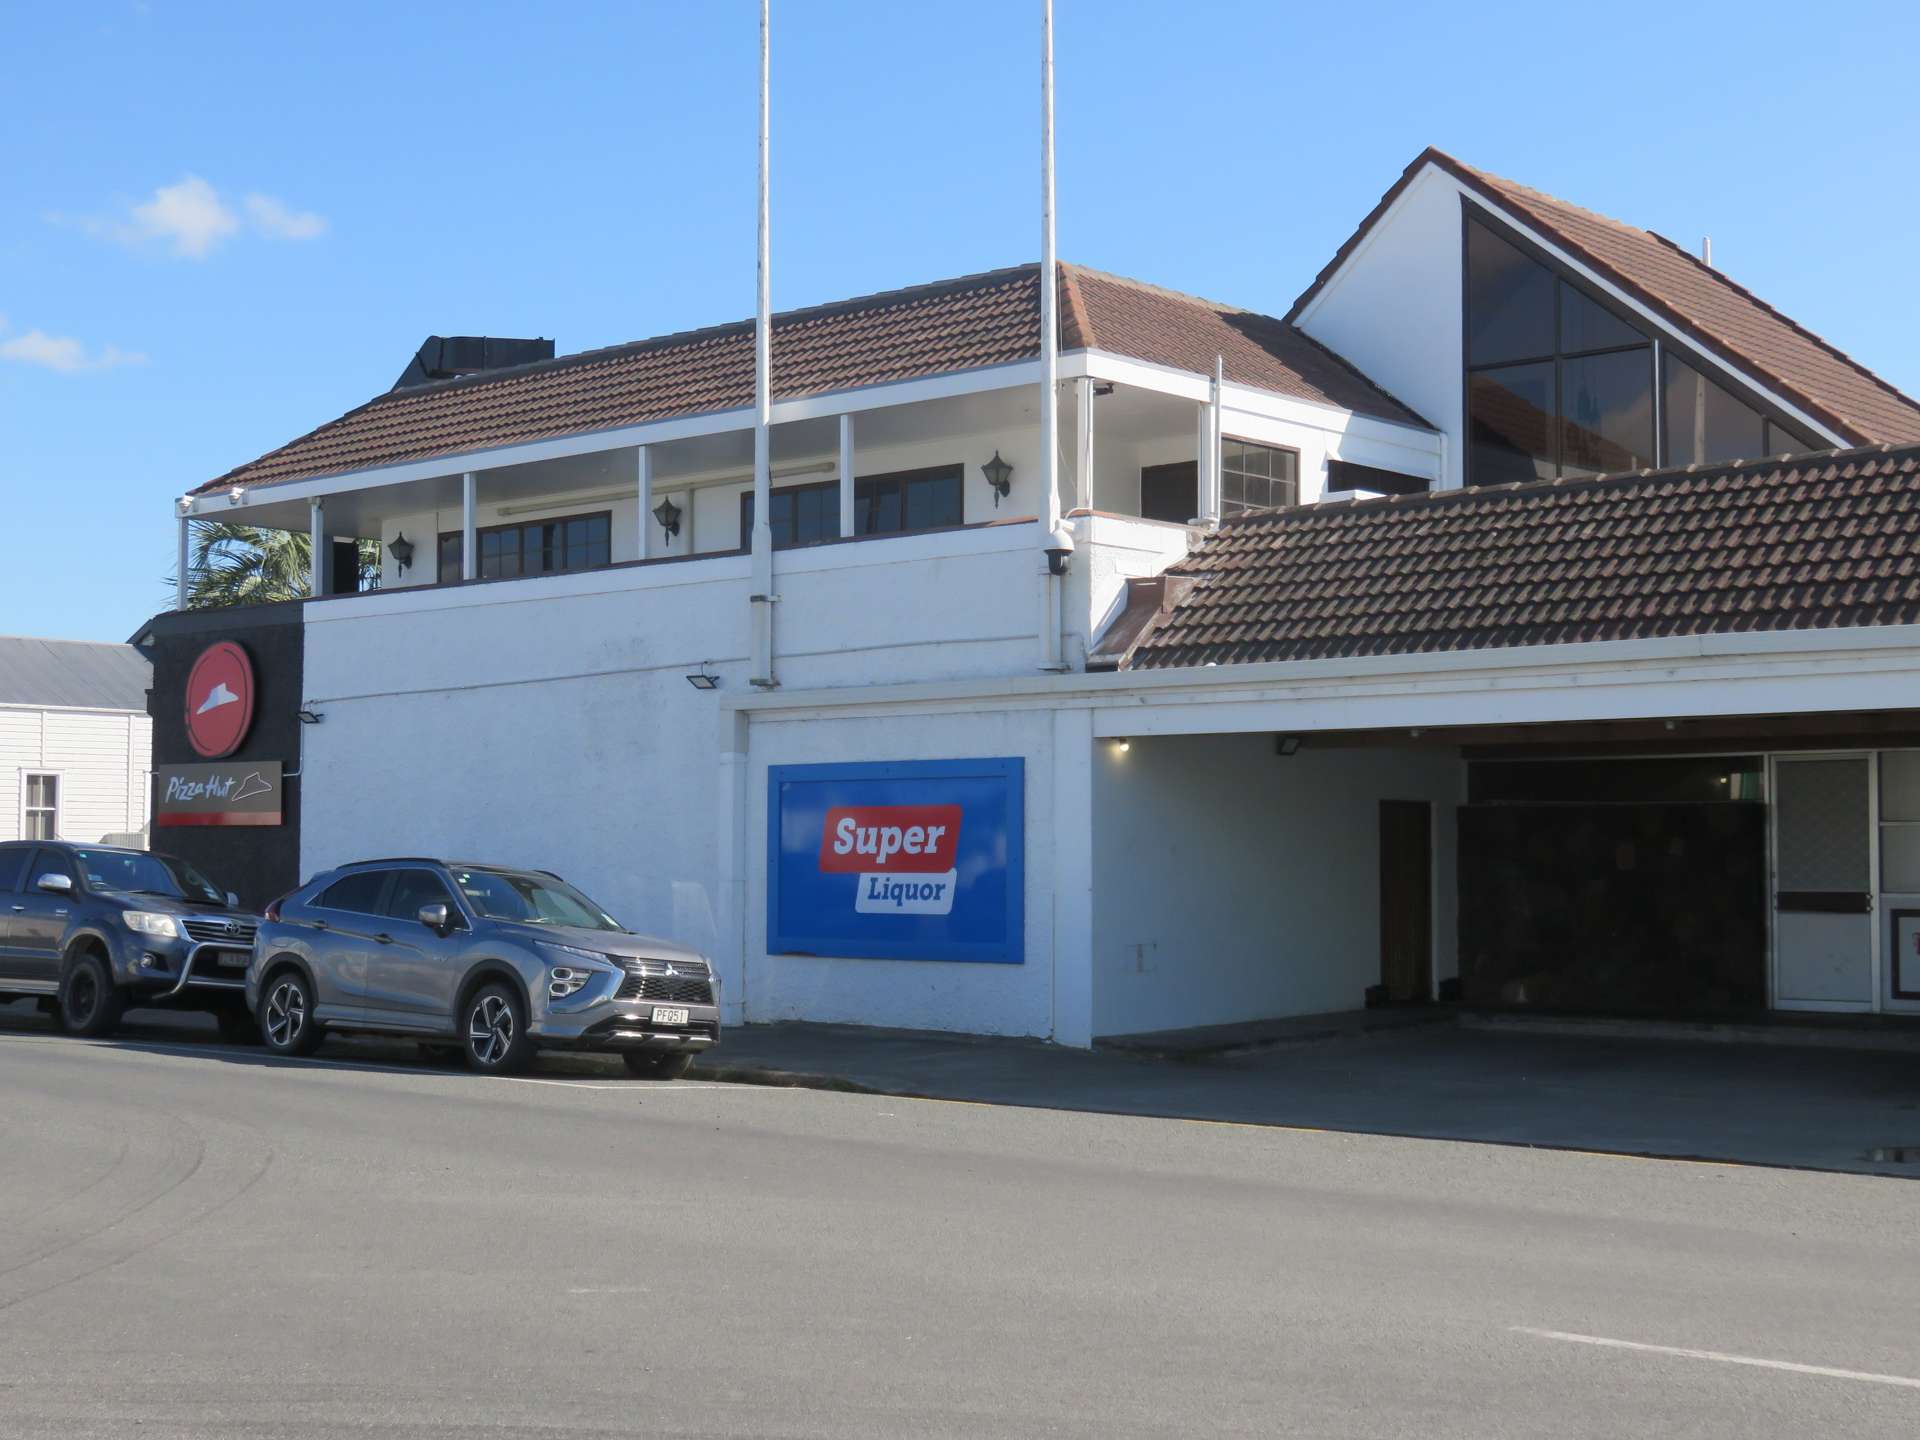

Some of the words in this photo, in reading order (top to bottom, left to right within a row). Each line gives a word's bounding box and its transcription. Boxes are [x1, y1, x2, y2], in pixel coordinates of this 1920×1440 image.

[165, 776, 203, 803] Pizza
[205, 774, 237, 799] Hut
[834, 818, 946, 864] Super
[868, 877, 946, 906] Liquor
